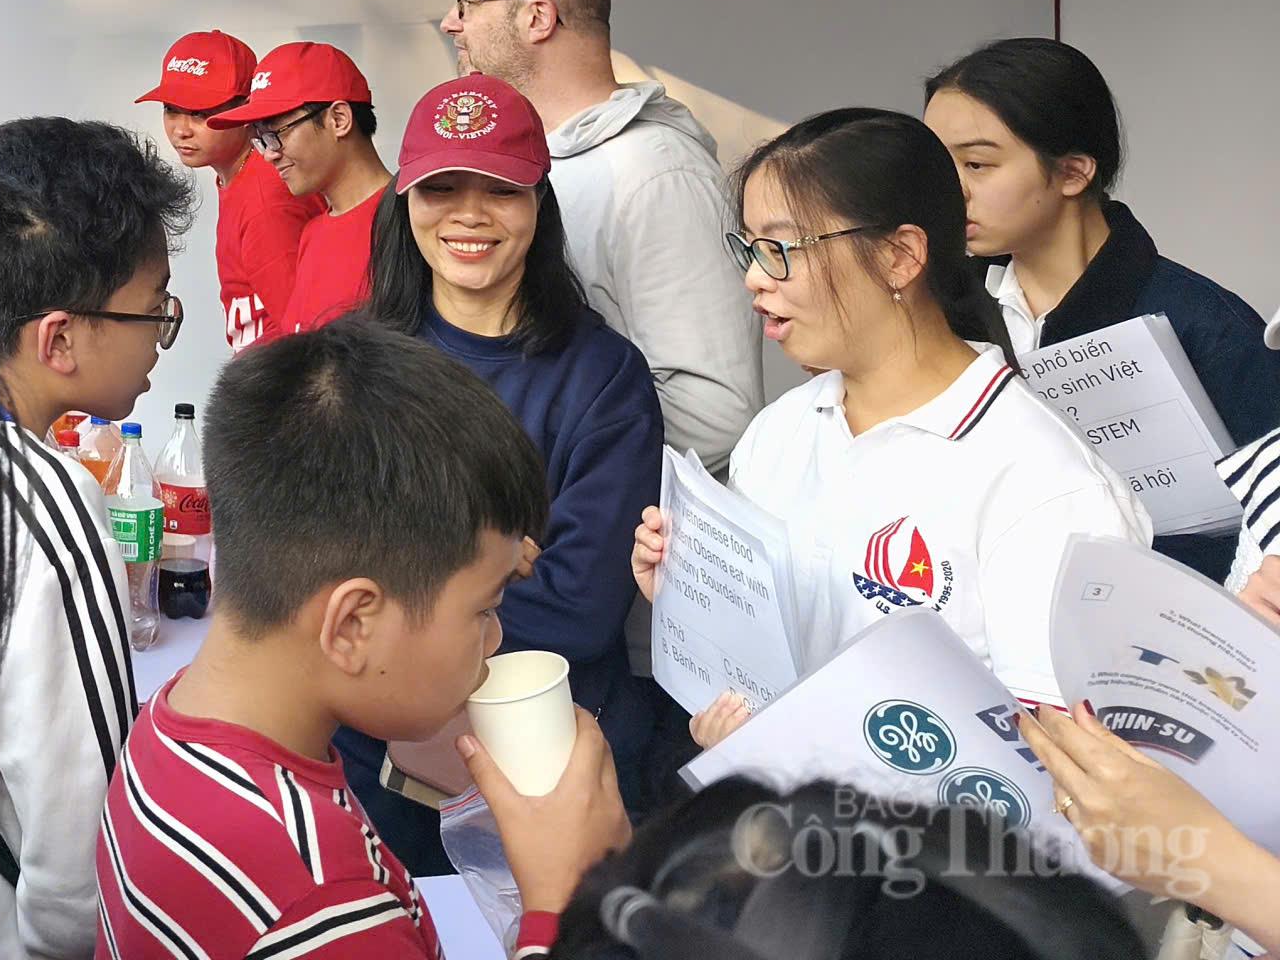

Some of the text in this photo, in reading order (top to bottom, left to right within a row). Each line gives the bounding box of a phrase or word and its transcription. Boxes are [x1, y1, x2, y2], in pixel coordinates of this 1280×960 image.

[1032, 349, 1068, 378] phổ
[1069, 338, 1113, 362] biến
[1061, 372, 1101, 396] sinh
[1100, 359, 1143, 382] Việt
[1086, 418, 1141, 445] STEM
[1130, 467, 1177, 492] ã hội
[730, 534, 754, 563] food
[693, 538, 728, 574] Obama
[729, 564, 746, 586] eat
[746, 574, 770, 601] with
[938, 560, 954, 605] 1995-2020
[682, 581, 711, 613] 2016?
[700, 567, 744, 612] Bourdain
[744, 596, 756, 618] in
[1092, 587, 1102, 596] 3
[671, 645, 697, 675] Bánh
[723, 658, 736, 679] C.
[735, 666, 759, 696] Bún
[760, 687, 777, 701] ch
[1103, 712, 1196, 744] CHIN-SU
